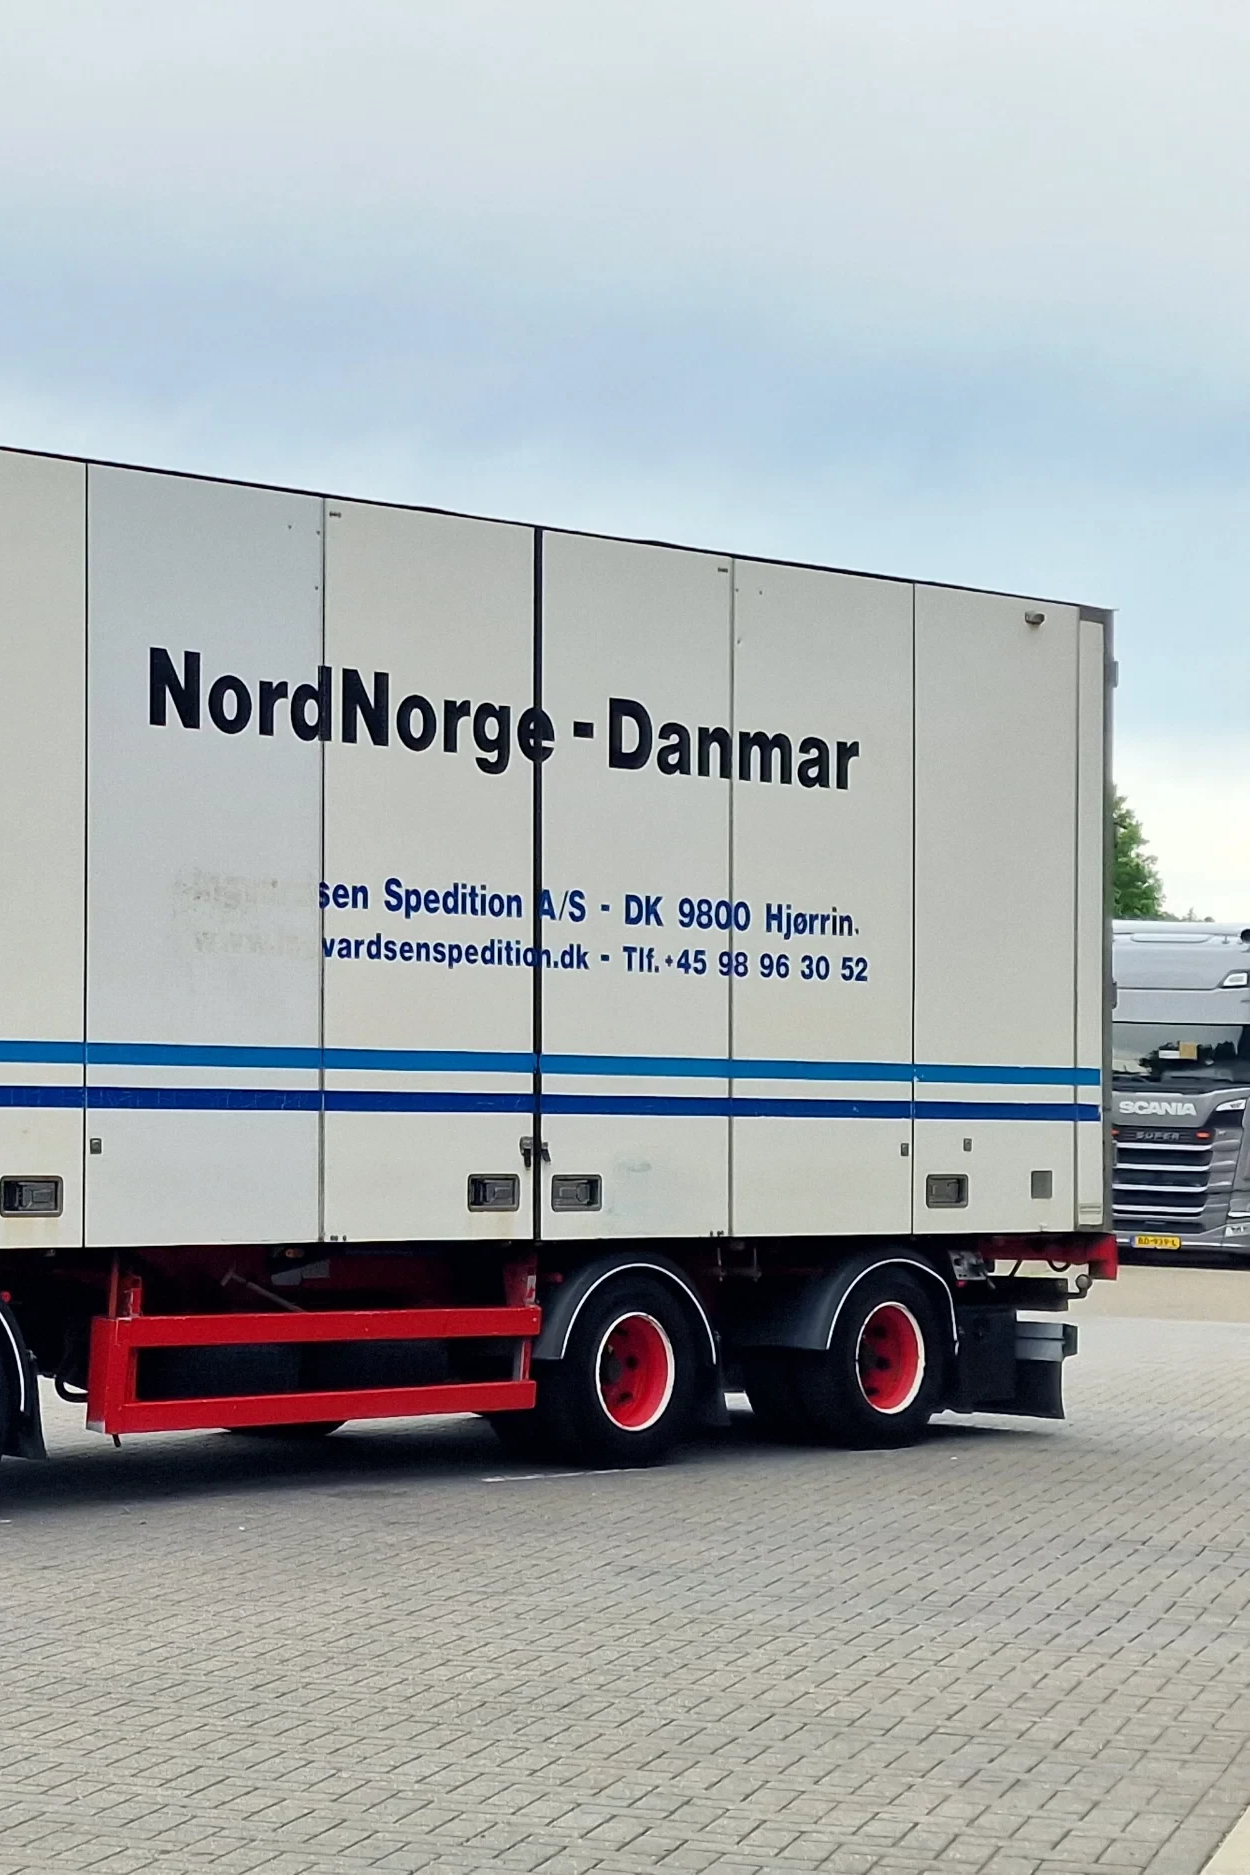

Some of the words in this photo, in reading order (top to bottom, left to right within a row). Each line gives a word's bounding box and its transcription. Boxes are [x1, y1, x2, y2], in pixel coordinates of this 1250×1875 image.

[150, 647, 555, 775] NordNorge
[573, 720, 594, 739] -
[609, 697, 860, 790] Danmar
[384, 877, 523, 918] Spedition
[537, 889, 586, 922] A/S
[625, 894, 664, 927] DK
[678, 898, 751, 932] 9800
[322, 932, 590, 969] vardsenspedition.dk
[718, 951, 749, 977] 98
[759, 953, 790, 979] 96
[800, 955, 830, 980] 30
[840, 957, 868, 982] 52
[1119, 1101, 1197, 1116] SCANIA
[1136, 1131, 1180, 1141] SUPER
